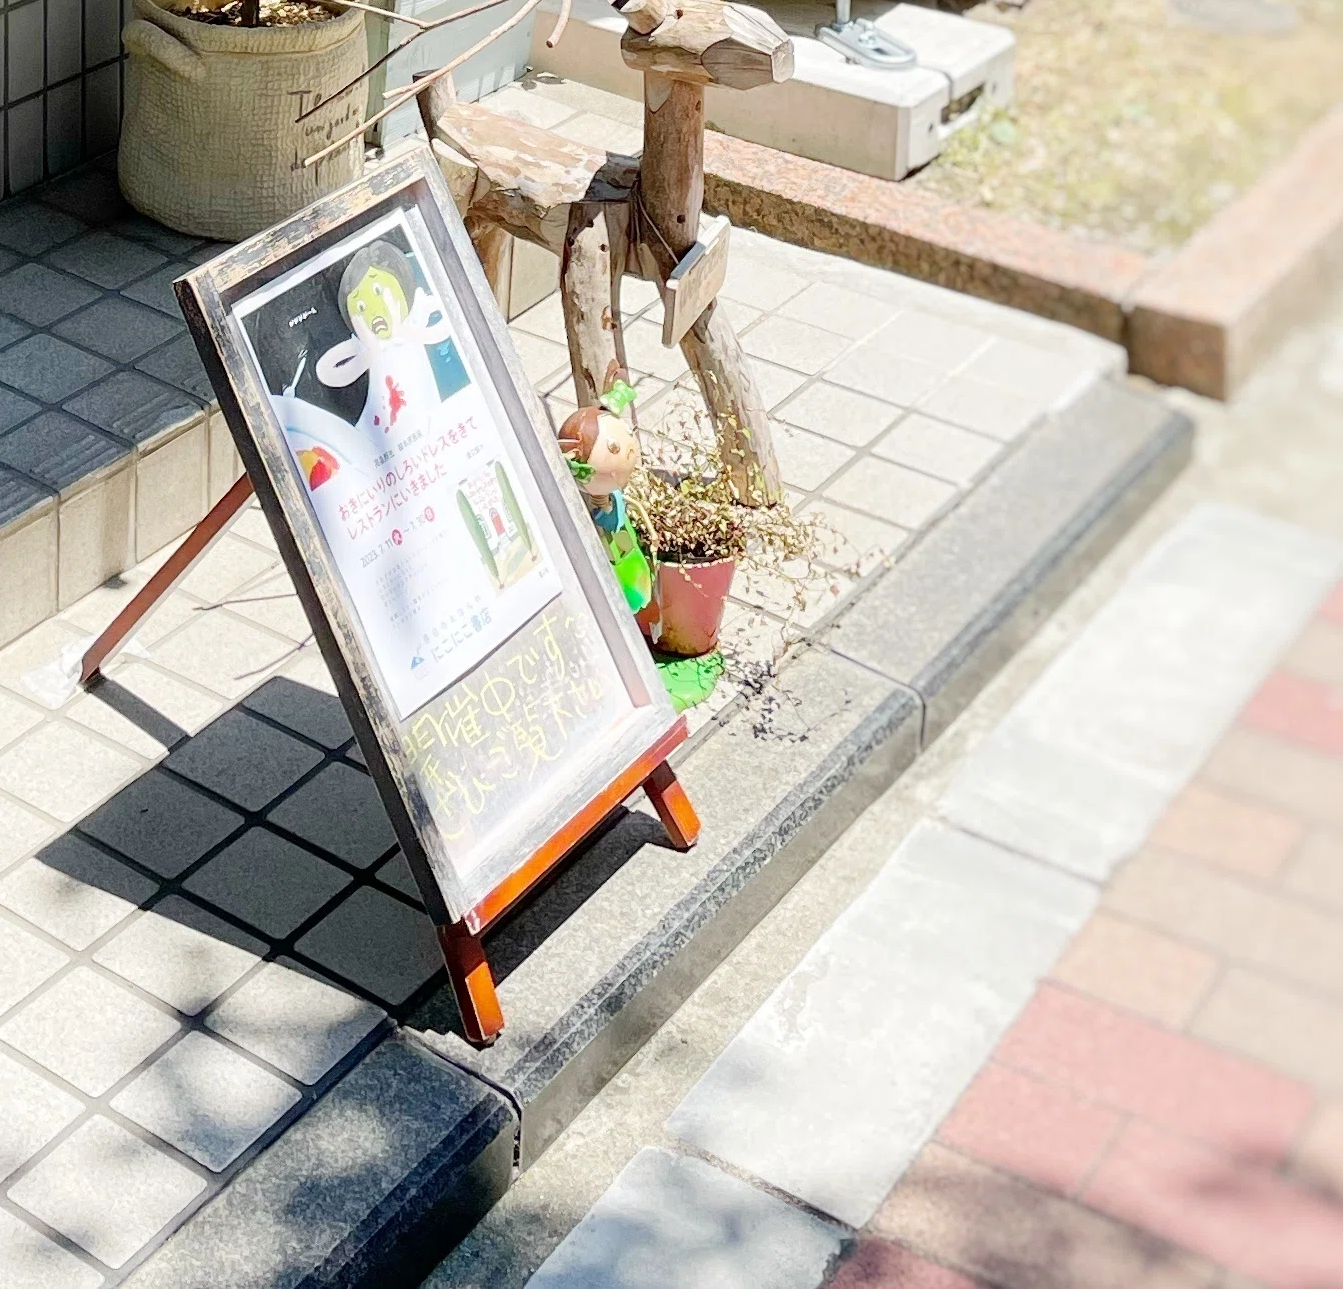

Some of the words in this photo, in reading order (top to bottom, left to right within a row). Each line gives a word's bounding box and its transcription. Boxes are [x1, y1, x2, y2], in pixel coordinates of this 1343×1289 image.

[347, 463, 448, 541] レストランにいきました
